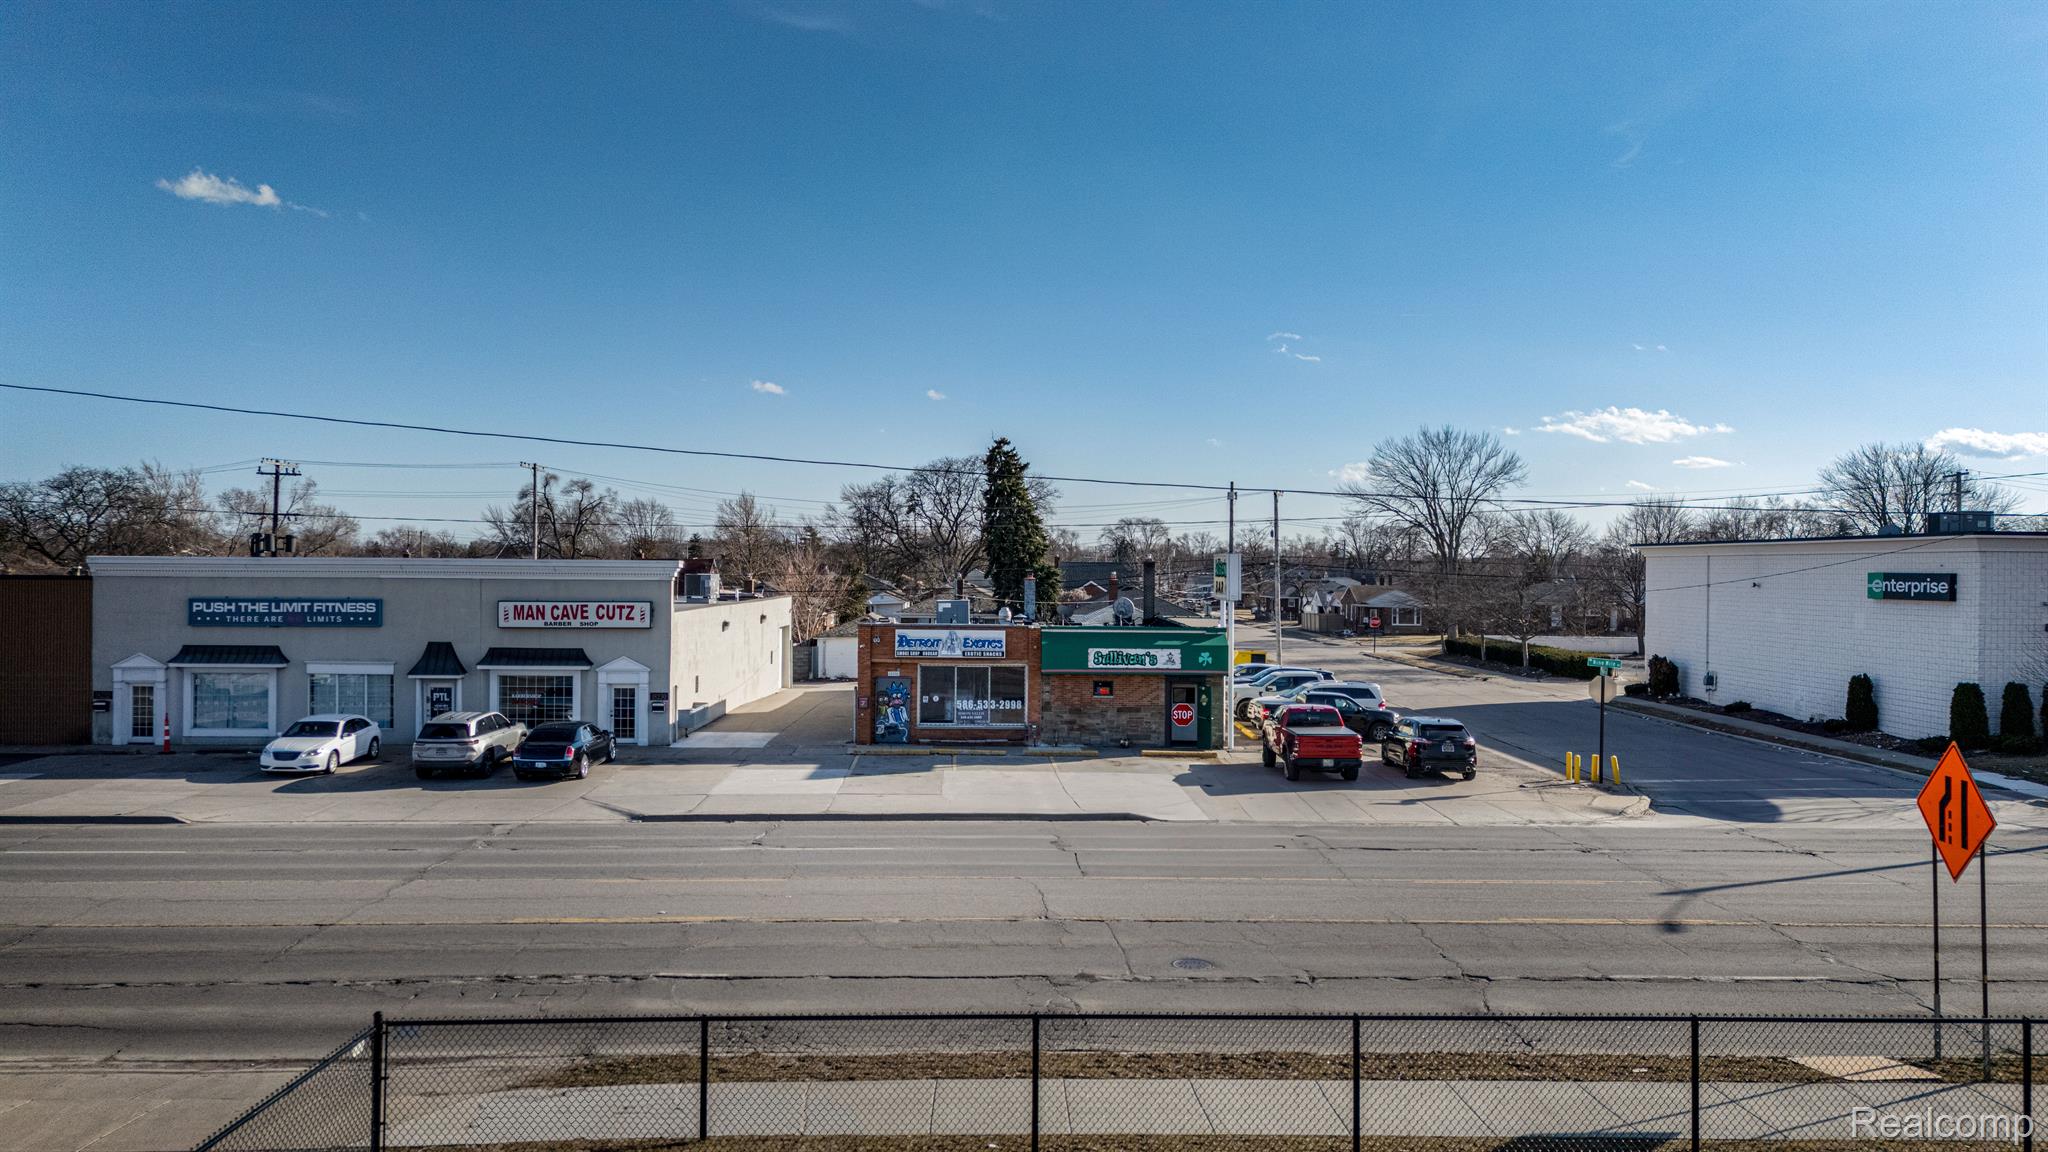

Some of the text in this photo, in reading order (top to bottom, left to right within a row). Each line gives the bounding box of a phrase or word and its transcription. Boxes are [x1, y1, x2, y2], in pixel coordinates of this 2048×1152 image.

[1871, 577, 1949, 597] enterprise
[192, 602, 377, 613] PUSH THE LIMIT FITNESS
[513, 604, 635, 621] MAN CAVE CUTZ
[226, 615, 260, 623] THERE
[263, 615, 284, 623] ARE
[306, 615, 343, 623] LIMITS
[1092, 650, 1158, 667] Sullivan's
[433, 692, 450, 701] PTL
[956, 700, 1022, 710] 586-533-2998
[1173, 710, 1193, 720] STOP
